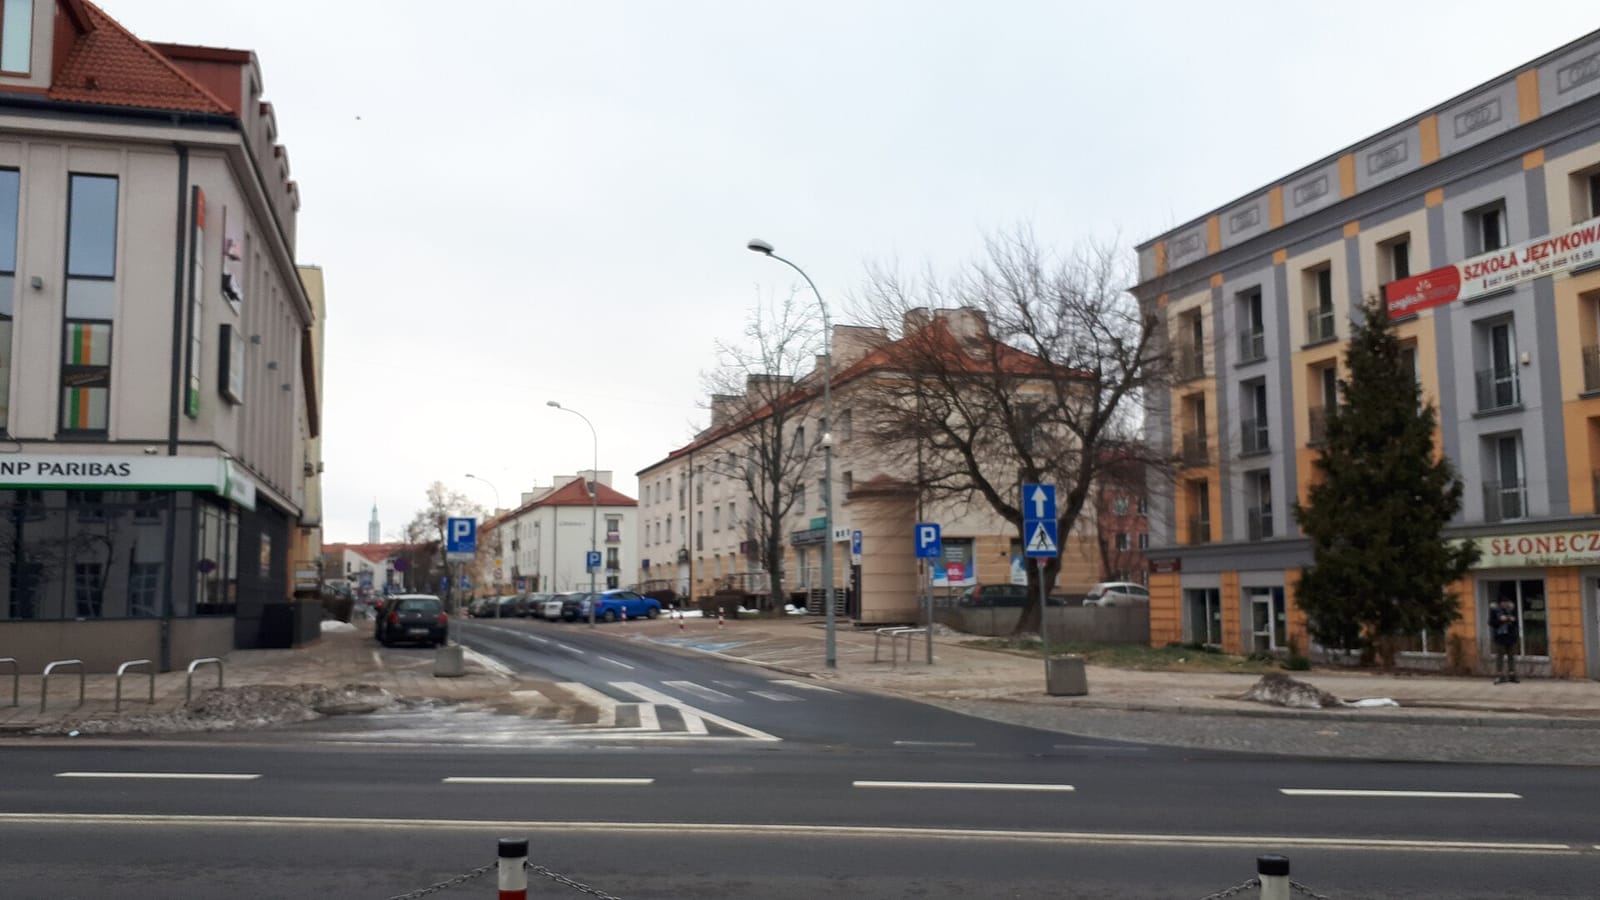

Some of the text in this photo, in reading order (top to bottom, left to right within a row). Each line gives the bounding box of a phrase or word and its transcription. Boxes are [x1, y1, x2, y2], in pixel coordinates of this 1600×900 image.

[1464, 251, 1518, 280] SZKOŁA
[38, 462, 131, 476] PARIBAS
[454, 520, 471, 542] P
[920, 526, 936, 549] P
[1491, 533, 1600, 556] SŁONECZ
[590, 552, 599, 565] P
